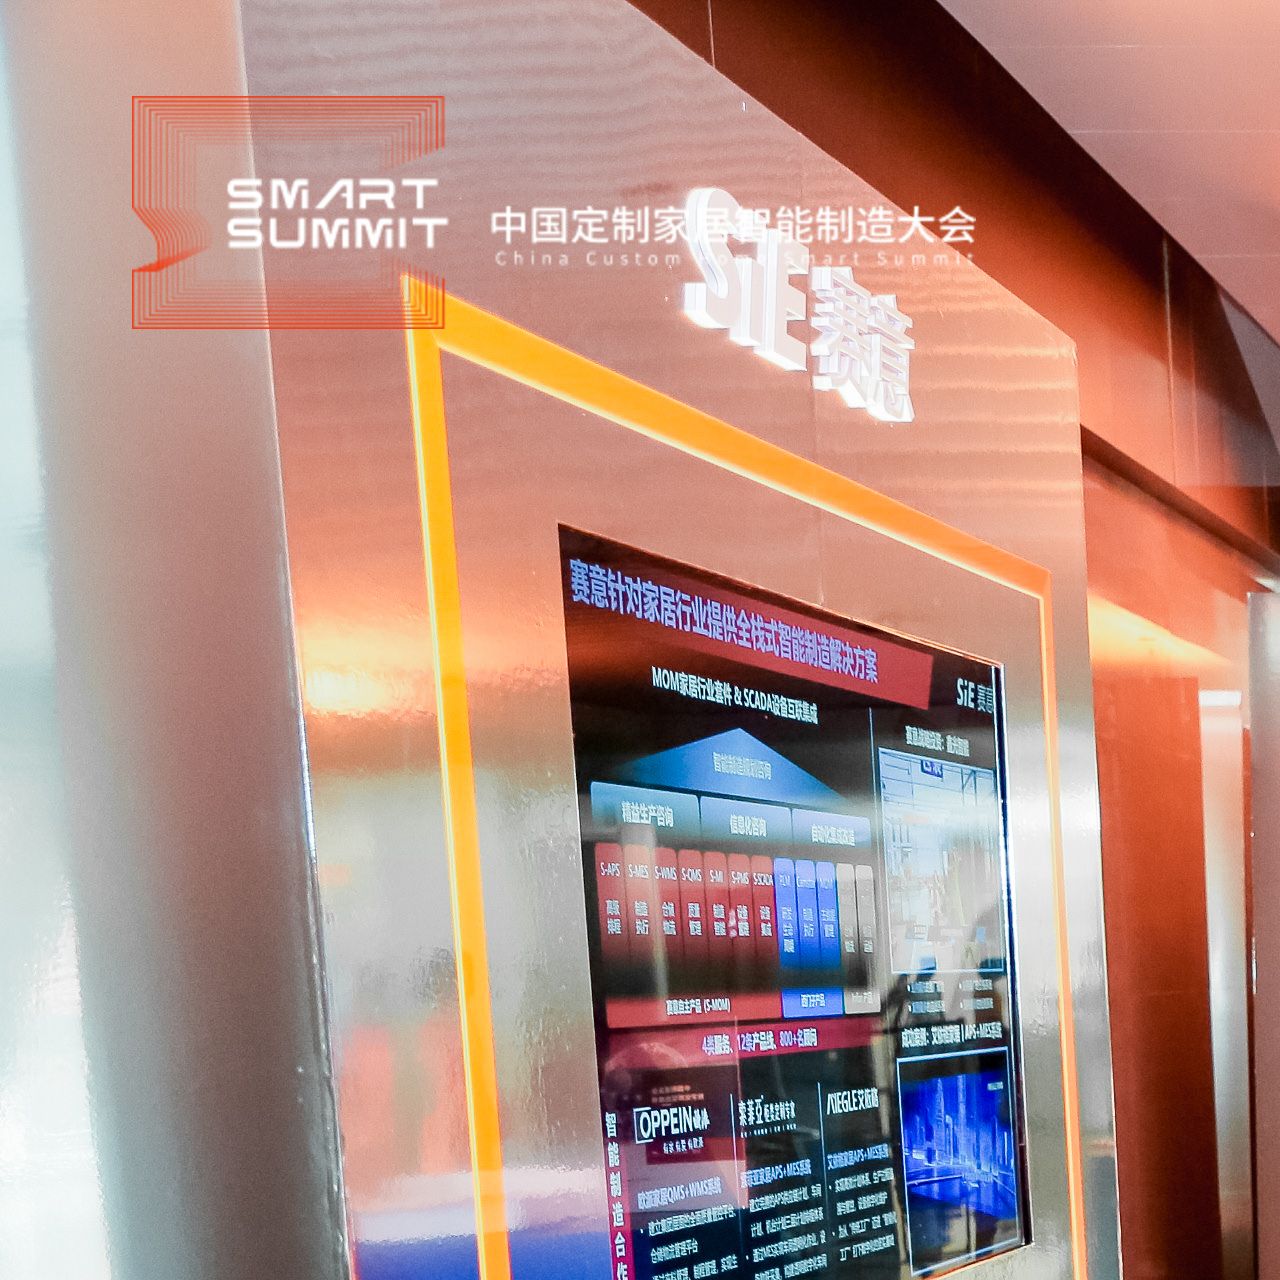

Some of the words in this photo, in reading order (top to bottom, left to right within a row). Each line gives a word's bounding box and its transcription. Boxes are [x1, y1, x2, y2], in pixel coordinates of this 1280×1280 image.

[569, 556, 877, 683] 赛意针对家居行业提供全栈式智能制造解决方案
[955, 676, 975, 709] SiE
